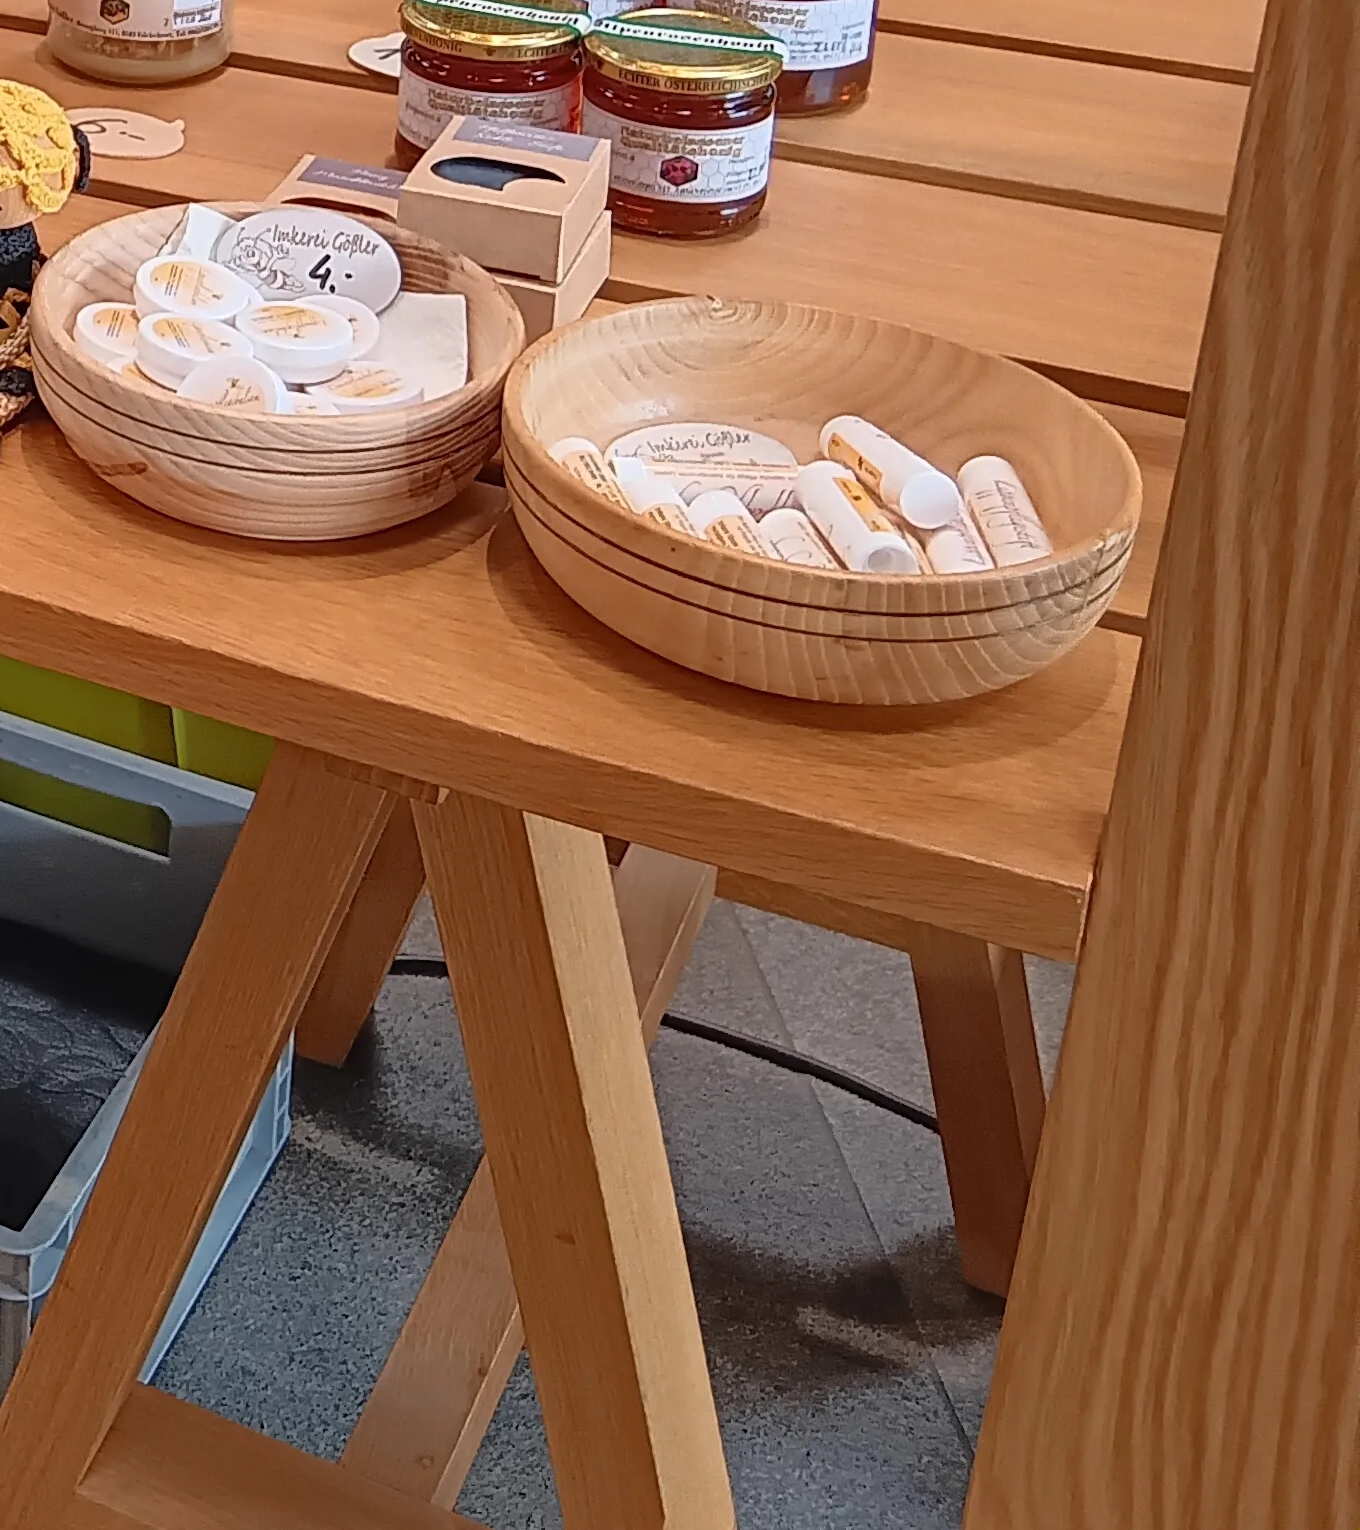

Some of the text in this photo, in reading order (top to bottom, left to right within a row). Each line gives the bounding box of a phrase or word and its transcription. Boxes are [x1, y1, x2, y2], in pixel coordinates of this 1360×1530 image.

[618, 69, 660, 88] ECHTER
[272, 223, 380, 256] Imkerei Gößler
